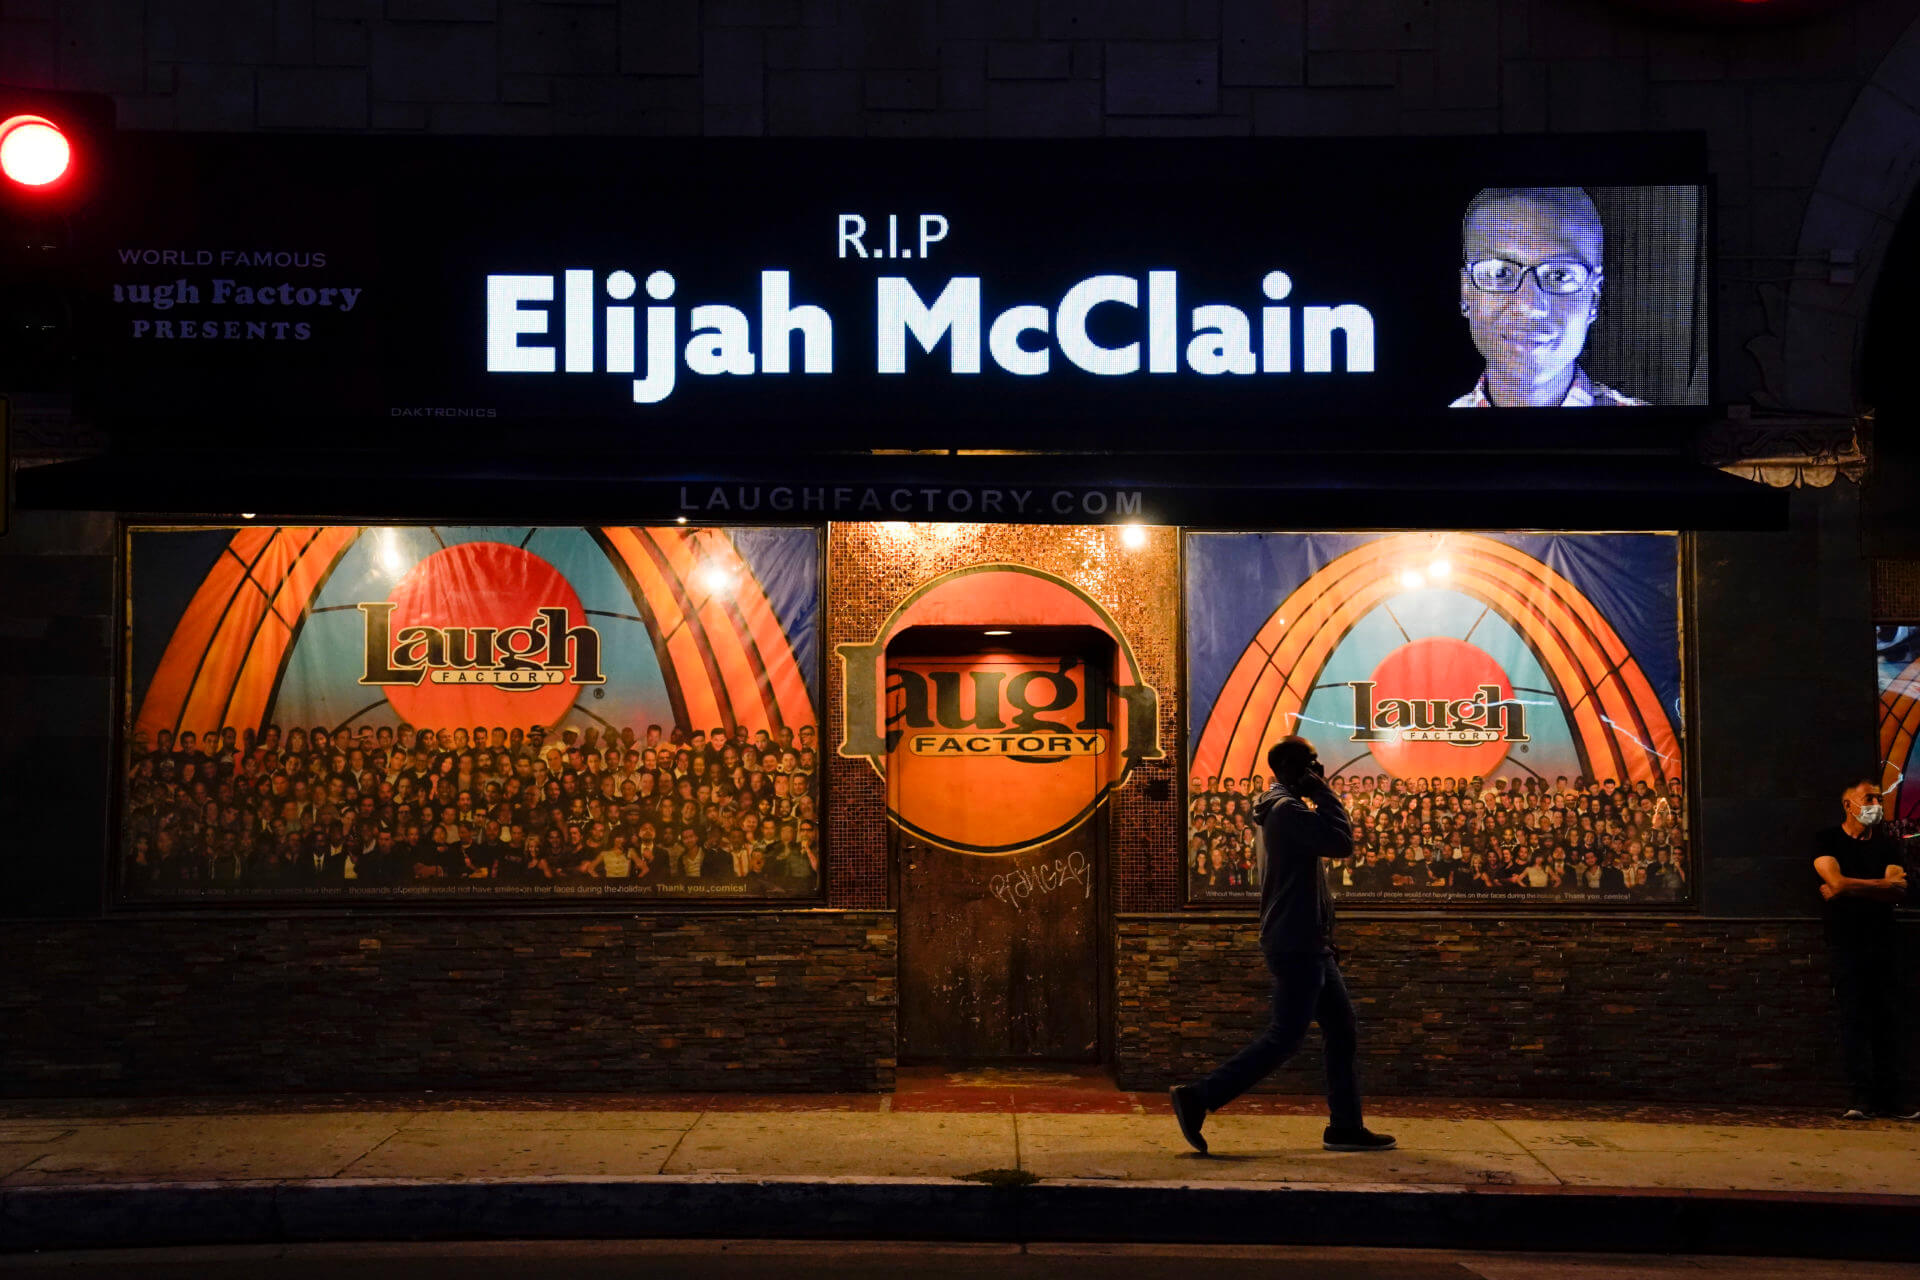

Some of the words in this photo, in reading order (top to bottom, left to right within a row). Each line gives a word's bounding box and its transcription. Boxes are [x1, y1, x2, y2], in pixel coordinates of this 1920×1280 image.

[838, 214, 949, 259] R.I.P
[118, 249, 214, 266] WORLD
[221, 251, 328, 269] FAMOUS
[210, 280, 362, 312] Factory
[131, 320, 312, 341] PRESENTS
[486, 269, 833, 404] Elijah
[877, 270, 1375, 376] McClain
[391, 407, 497, 418] DAKTRONICS
[679, 486, 1143, 516] LAUGHFACTORY.COM
[358, 602, 606, 691] Laugh
[442, 671, 555, 683] FACTORY
[836, 642, 1166, 764] Laugh
[1349, 682, 1531, 747] Laugh
[915, 735, 1097, 753] FACTORY
[1410, 731, 1492, 741] FACTORY
[656, 883, 686, 893] Thank
[711, 883, 748, 893] comics!
